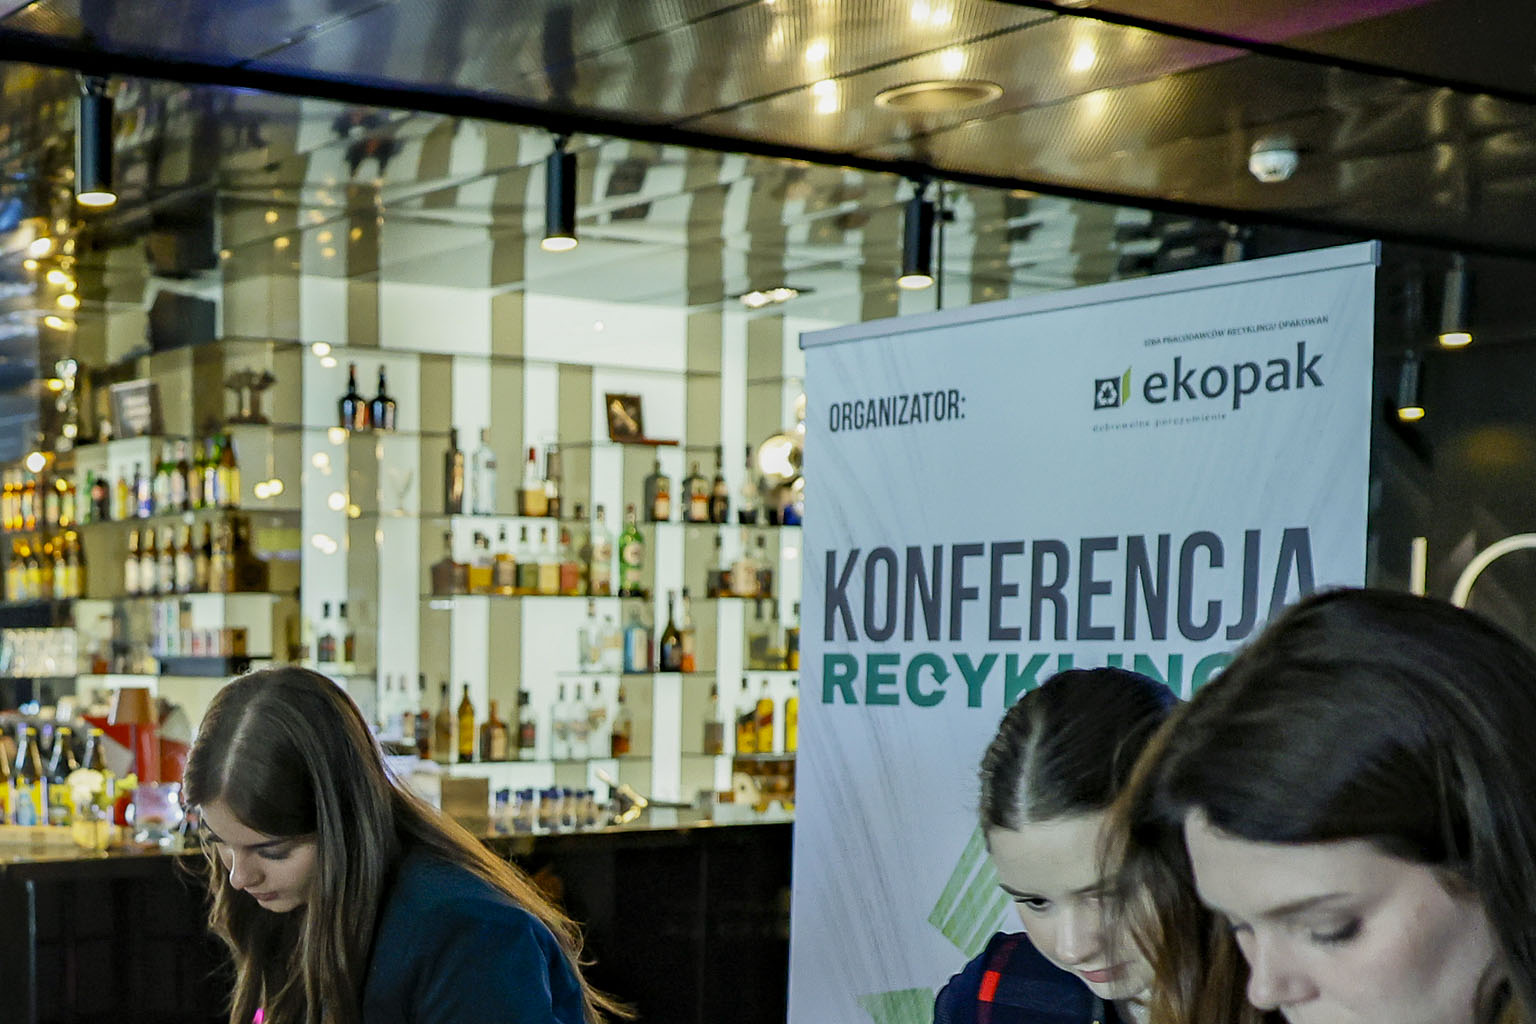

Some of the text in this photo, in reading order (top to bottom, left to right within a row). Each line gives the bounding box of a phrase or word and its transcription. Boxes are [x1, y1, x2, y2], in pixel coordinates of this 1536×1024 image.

[1143, 341, 1324, 411] ekopak
[829, 389, 966, 433] ORGANIZATOR:
[822, 653, 1238, 709] RECYKN
